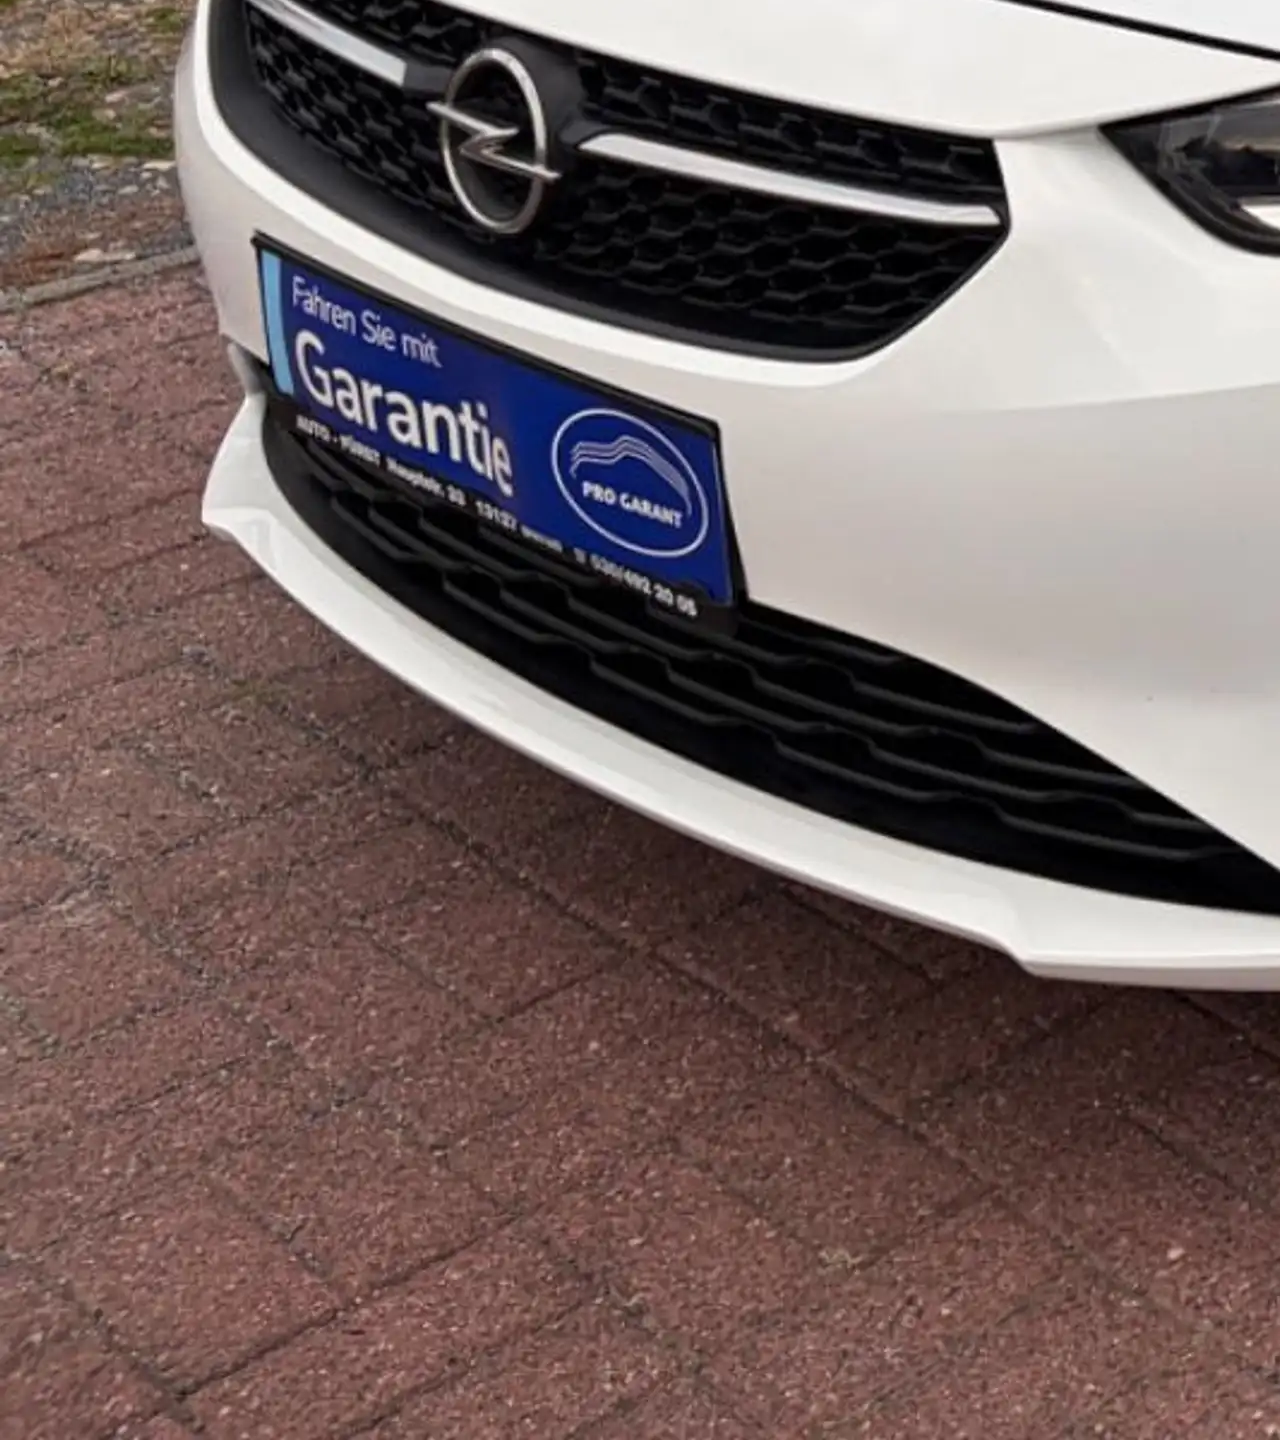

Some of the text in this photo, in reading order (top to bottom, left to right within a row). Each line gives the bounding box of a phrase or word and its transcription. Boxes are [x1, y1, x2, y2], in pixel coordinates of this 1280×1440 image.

[291, 274, 443, 369] Fahren Sie mit
[295, 328, 514, 498] Garantie
[582, 480, 683, 529] PRO GARANT
